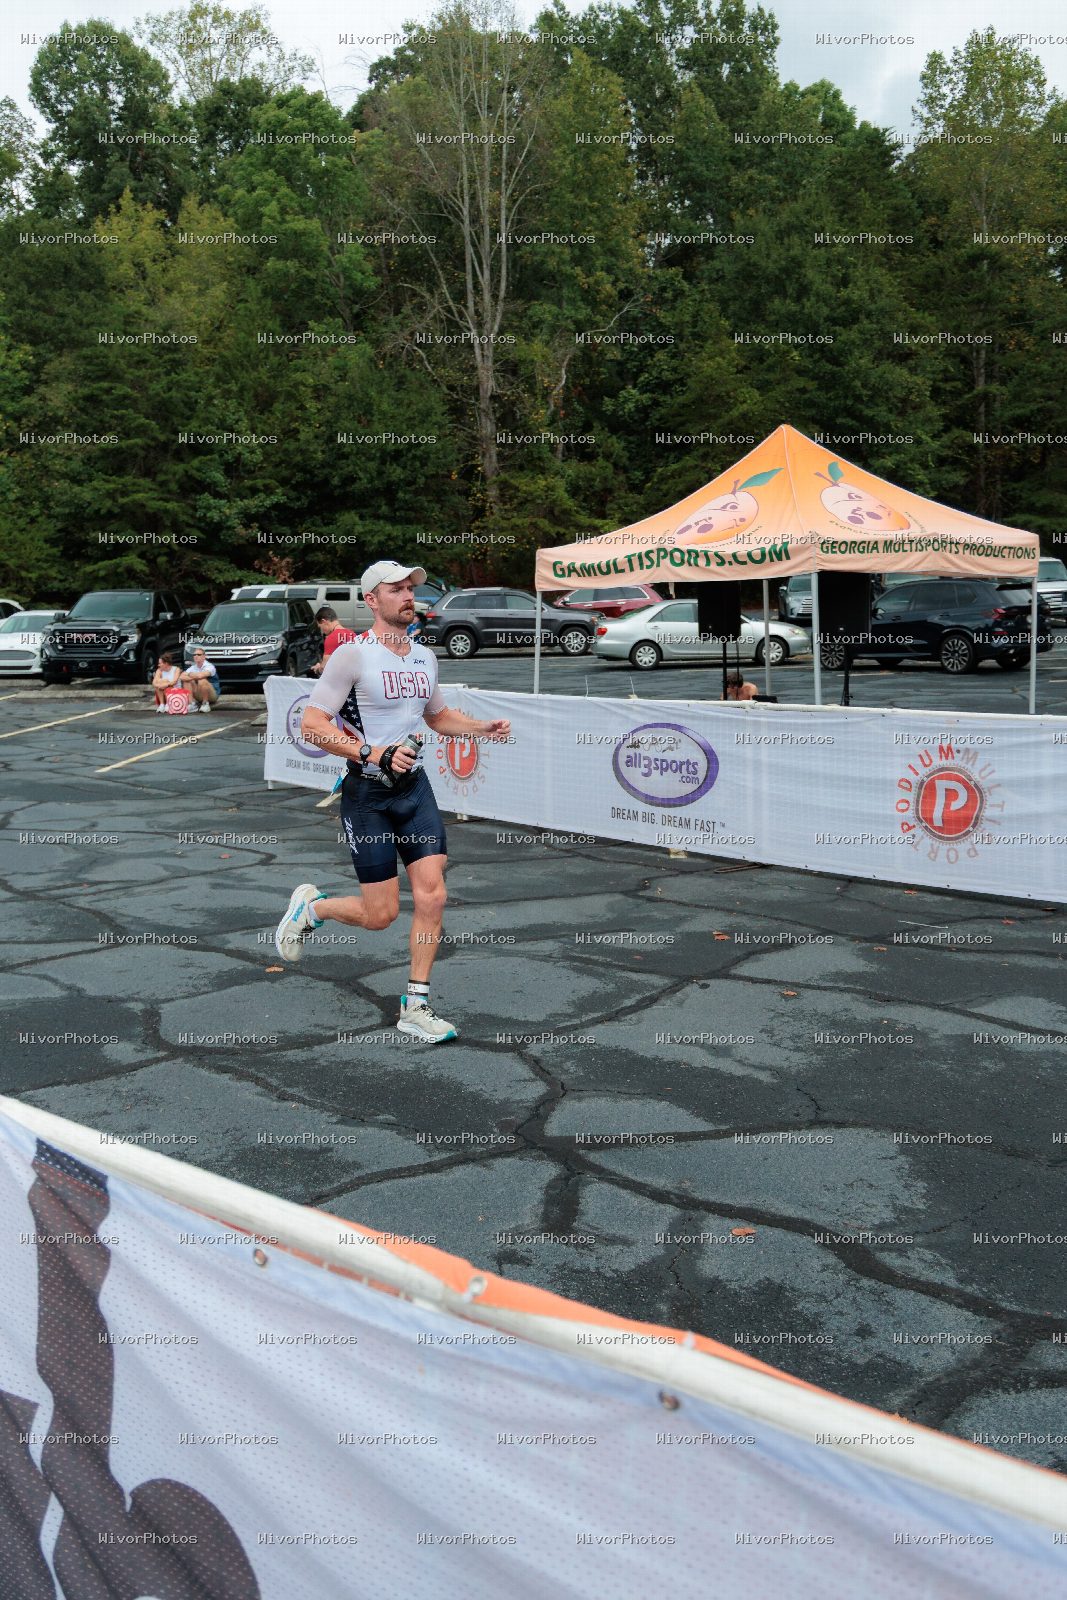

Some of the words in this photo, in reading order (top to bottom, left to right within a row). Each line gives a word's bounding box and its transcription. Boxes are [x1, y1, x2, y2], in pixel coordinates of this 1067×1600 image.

[552, 541, 791, 578] GAMULTISPORTS.COM
[821, 540, 880, 554] GEORGIA
[882, 538, 960, 554] MULTISPORTS
[962, 542, 1036, 560] PRODUCTIONS
[382, 671, 430, 699] USA
[625, 752, 699, 778] all3sports
[678, 776, 700, 785] .com
[895, 743, 955, 834] PODIUM
[912, 746, 1006, 864] MULTIPORT
[932, 779, 968, 827] P
[611, 807, 639, 822] DREAM
[641, 811, 658, 825] BIG.
[661, 814, 691, 830] DREAM
